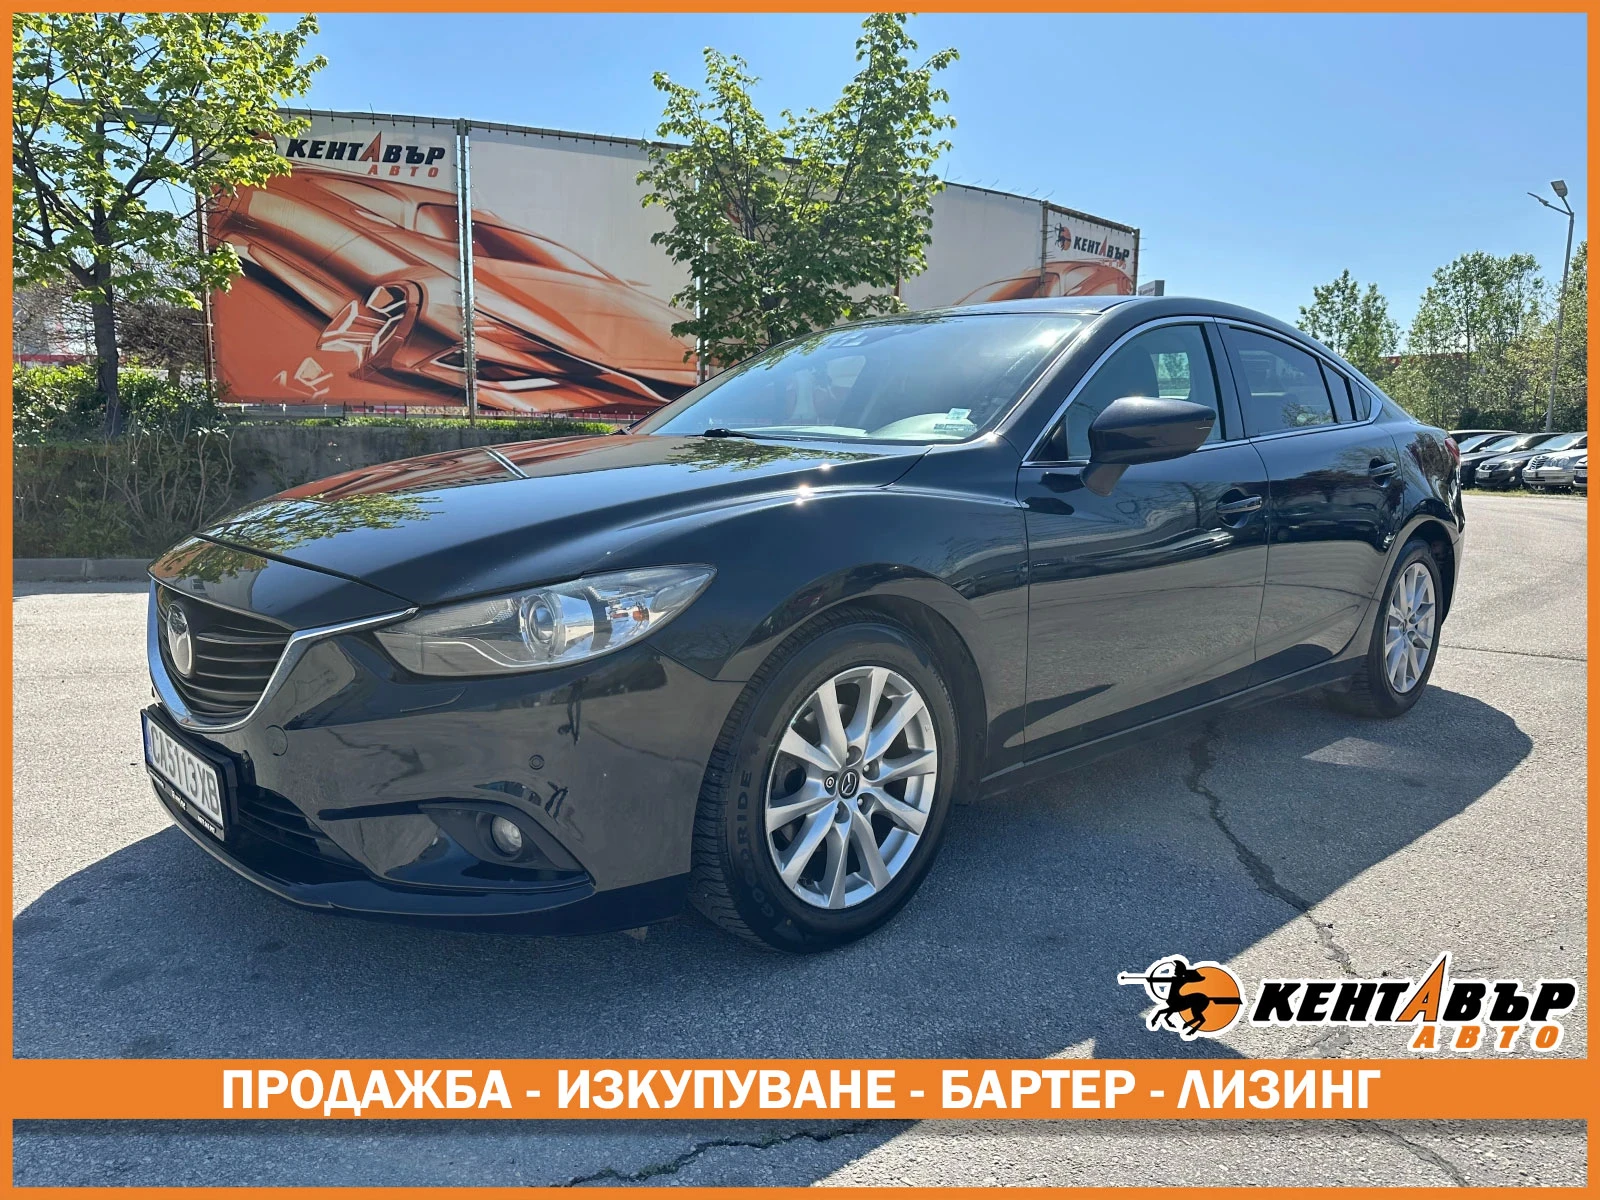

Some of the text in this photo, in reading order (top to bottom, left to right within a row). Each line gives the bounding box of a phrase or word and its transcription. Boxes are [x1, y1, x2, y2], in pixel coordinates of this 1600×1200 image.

[286, 131, 446, 166] КЕНТАВЪР
[368, 164, 440, 178] АВТО
[1073, 234, 1130, 261] КЕНТАВЪР
